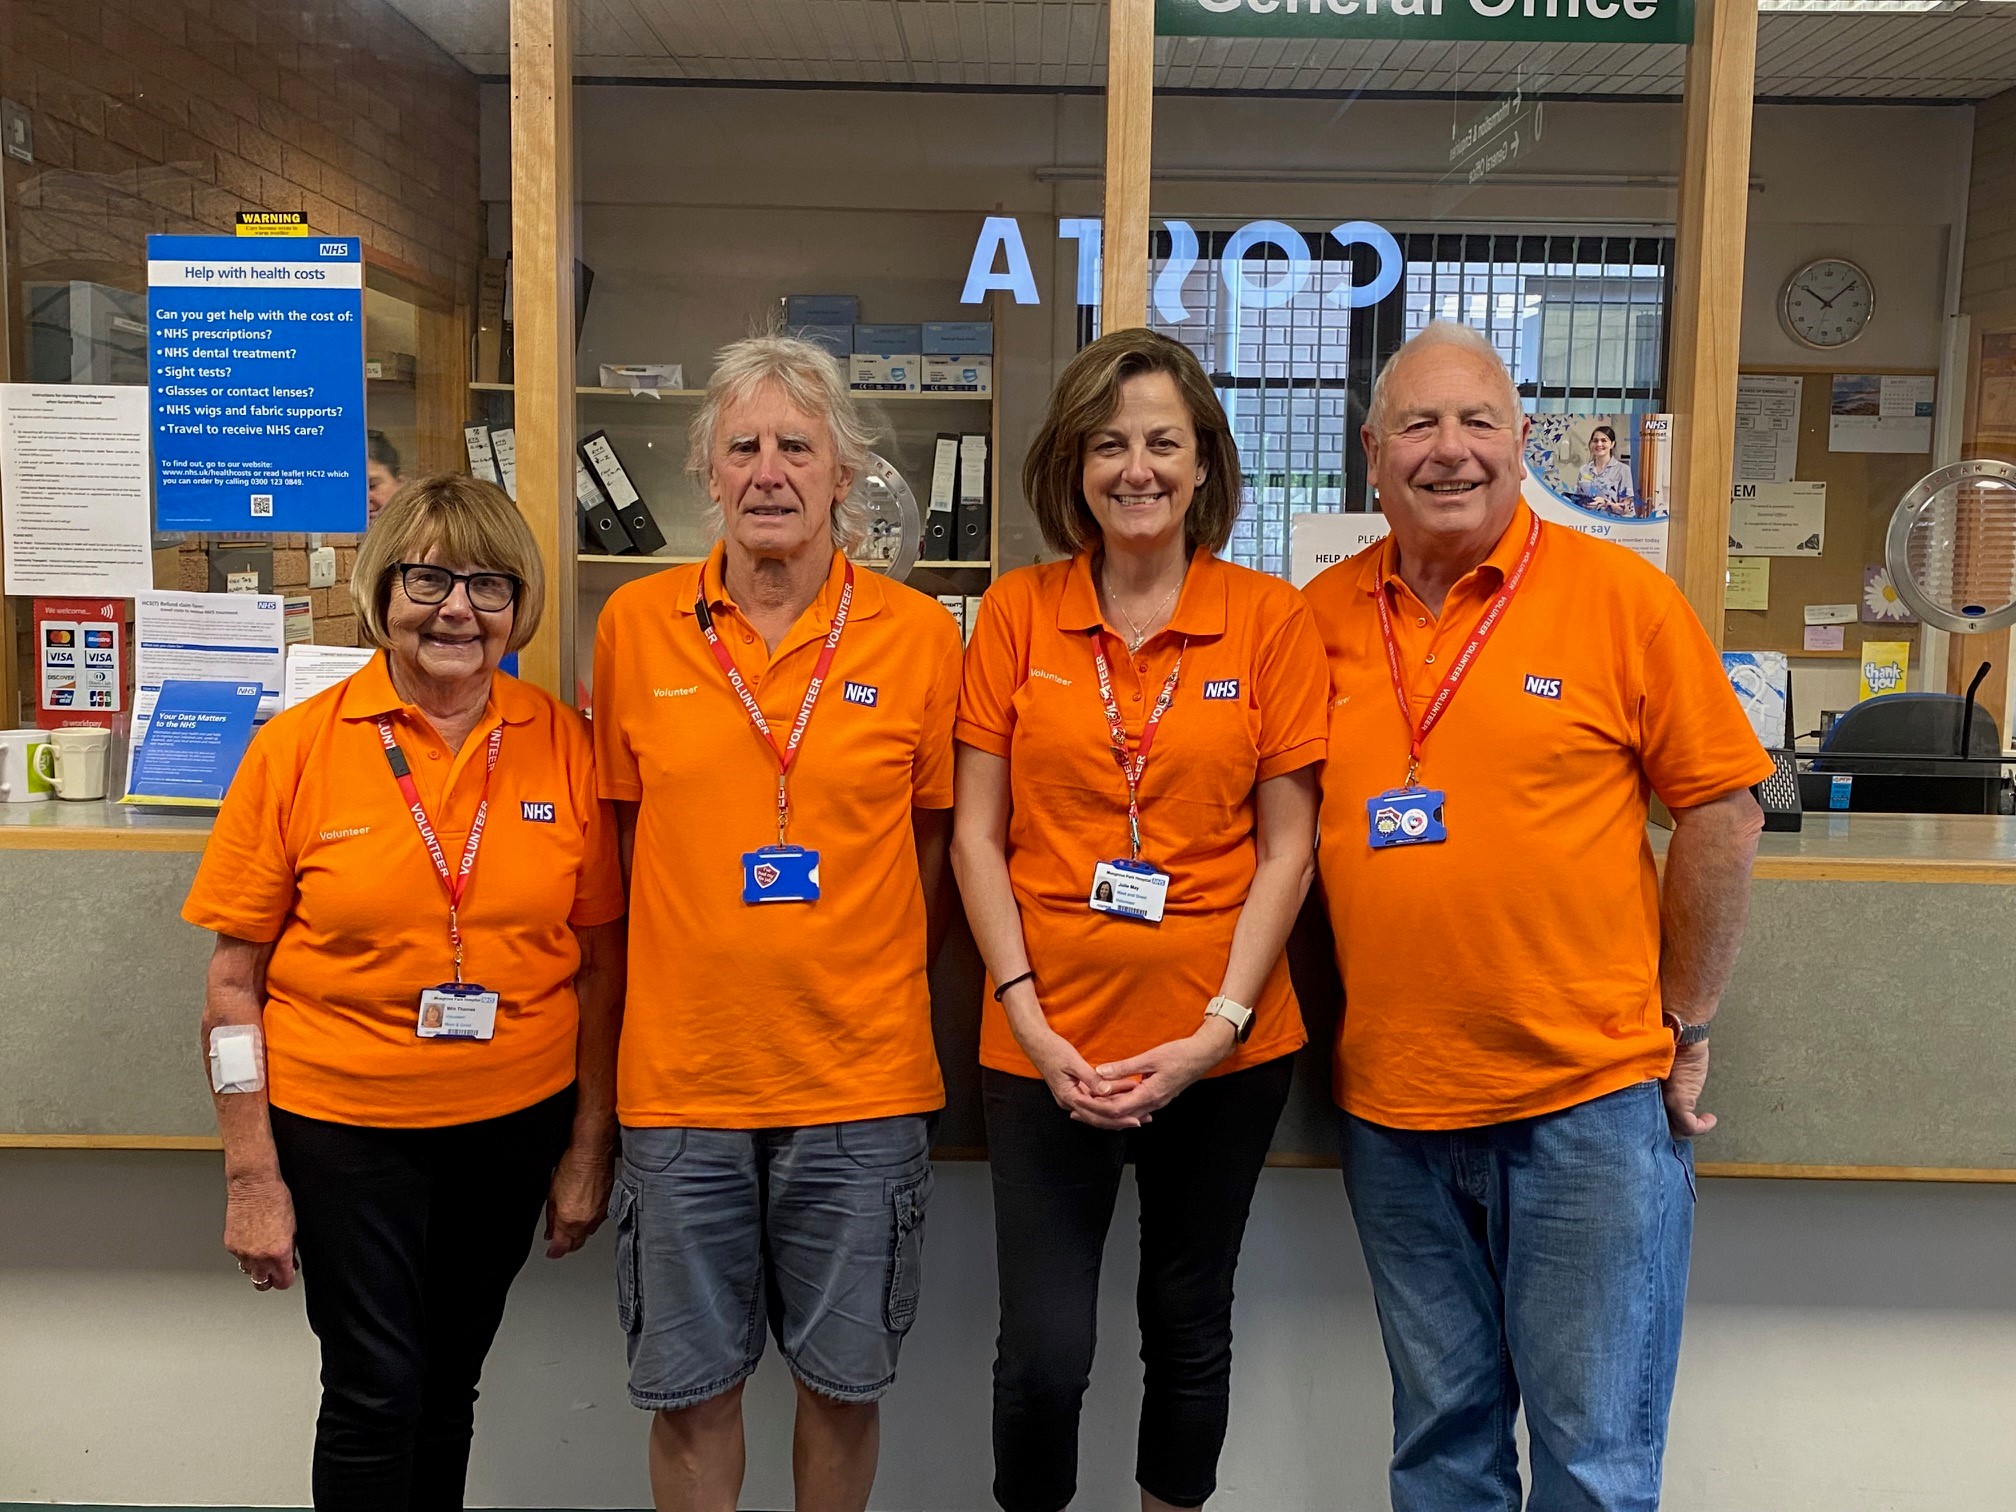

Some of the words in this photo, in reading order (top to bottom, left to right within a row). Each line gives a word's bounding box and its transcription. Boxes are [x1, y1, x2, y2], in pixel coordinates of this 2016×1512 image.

[242, 213, 301, 223] WARNING
[321, 245, 347, 255] NHS
[185, 266, 214, 281] Help
[218, 267, 246, 279] with
[251, 267, 290, 279] health
[294, 268, 325, 280] costs
[156, 309, 178, 320] Can
[181, 311, 203, 322] you
[207, 311, 226, 322] get
[229, 310, 254, 322] help
[258, 310, 284, 321] with
[288, 310, 307, 321] the
[311, 311, 334, 322] cost
[337, 311, 353, 322] of:
[164, 329, 188, 339] NHS
[192, 329, 272, 341] prescriptions?
[164, 348, 189, 358] NHS
[193, 348, 229, 358] dental
[233, 349, 297, 359] treatment?
[165, 367, 195, 379] Sight
[198, 367, 232, 378] tests?
[165, 386, 208, 397] Glasses
[211, 388, 224, 396] or
[227, 387, 270, 397] contact
[273, 386, 315, 398] lenses?
[166, 405, 191, 415] NHS
[194, 405, 222, 418] wigs
[225, 405, 247, 416] and
[250, 405, 284, 416] fabric
[287, 406, 343, 419] supports?
[167, 424, 202, 434] Travel
[206, 425, 218, 435] to
[222, 425, 263, 435] receive
[266, 425, 291, 435] NHS
[294, 425, 325, 436] care?
[1646, 421, 1667, 430] NHS
[162, 469, 251, 477] www.nhs.uk/healthcosts
[307, 470, 325, 478] HC12
[327, 470, 349, 478] which
[214, 478, 224, 486] by
[226, 478, 249, 486] calling
[1731, 485, 1756, 497] EM
[1591, 524, 1611, 535] say
[1316, 554, 1341, 563] HELP
[1508, 552, 1531, 590] VOLUNTEER
[258, 602, 276, 610] NHS
[825, 582, 853, 650] VOLUNTEER
[1478, 596, 1507, 636] VOLUNTEER
[50, 652, 73, 662] VISA
[89, 653, 112, 662] VISA
[1449, 641, 1479, 682] VOLUNTEER
[1864, 661, 1903, 679] thank
[1030, 668, 1073, 687] Volunteer
[1869, 676, 1896, 692] you
[653, 685, 699, 698] Volunteer
[1205, 681, 1237, 698] NHS
[1526, 676, 1561, 698] NHS
[845, 684, 877, 705] NHS
[727, 667, 770, 736] VOLUNTEER
[786, 677, 824, 750] VOLUNTEER
[1421, 688, 1451, 731] VOLUNTEER
[178, 713, 196, 721] Data
[197, 714, 227, 723] Matters
[523, 803, 553, 821] NHS
[319, 825, 371, 842] Volunteer
[411, 802, 450, 878] VOLUNTEER
[459, 800, 488, 876] VOLUNTEER
